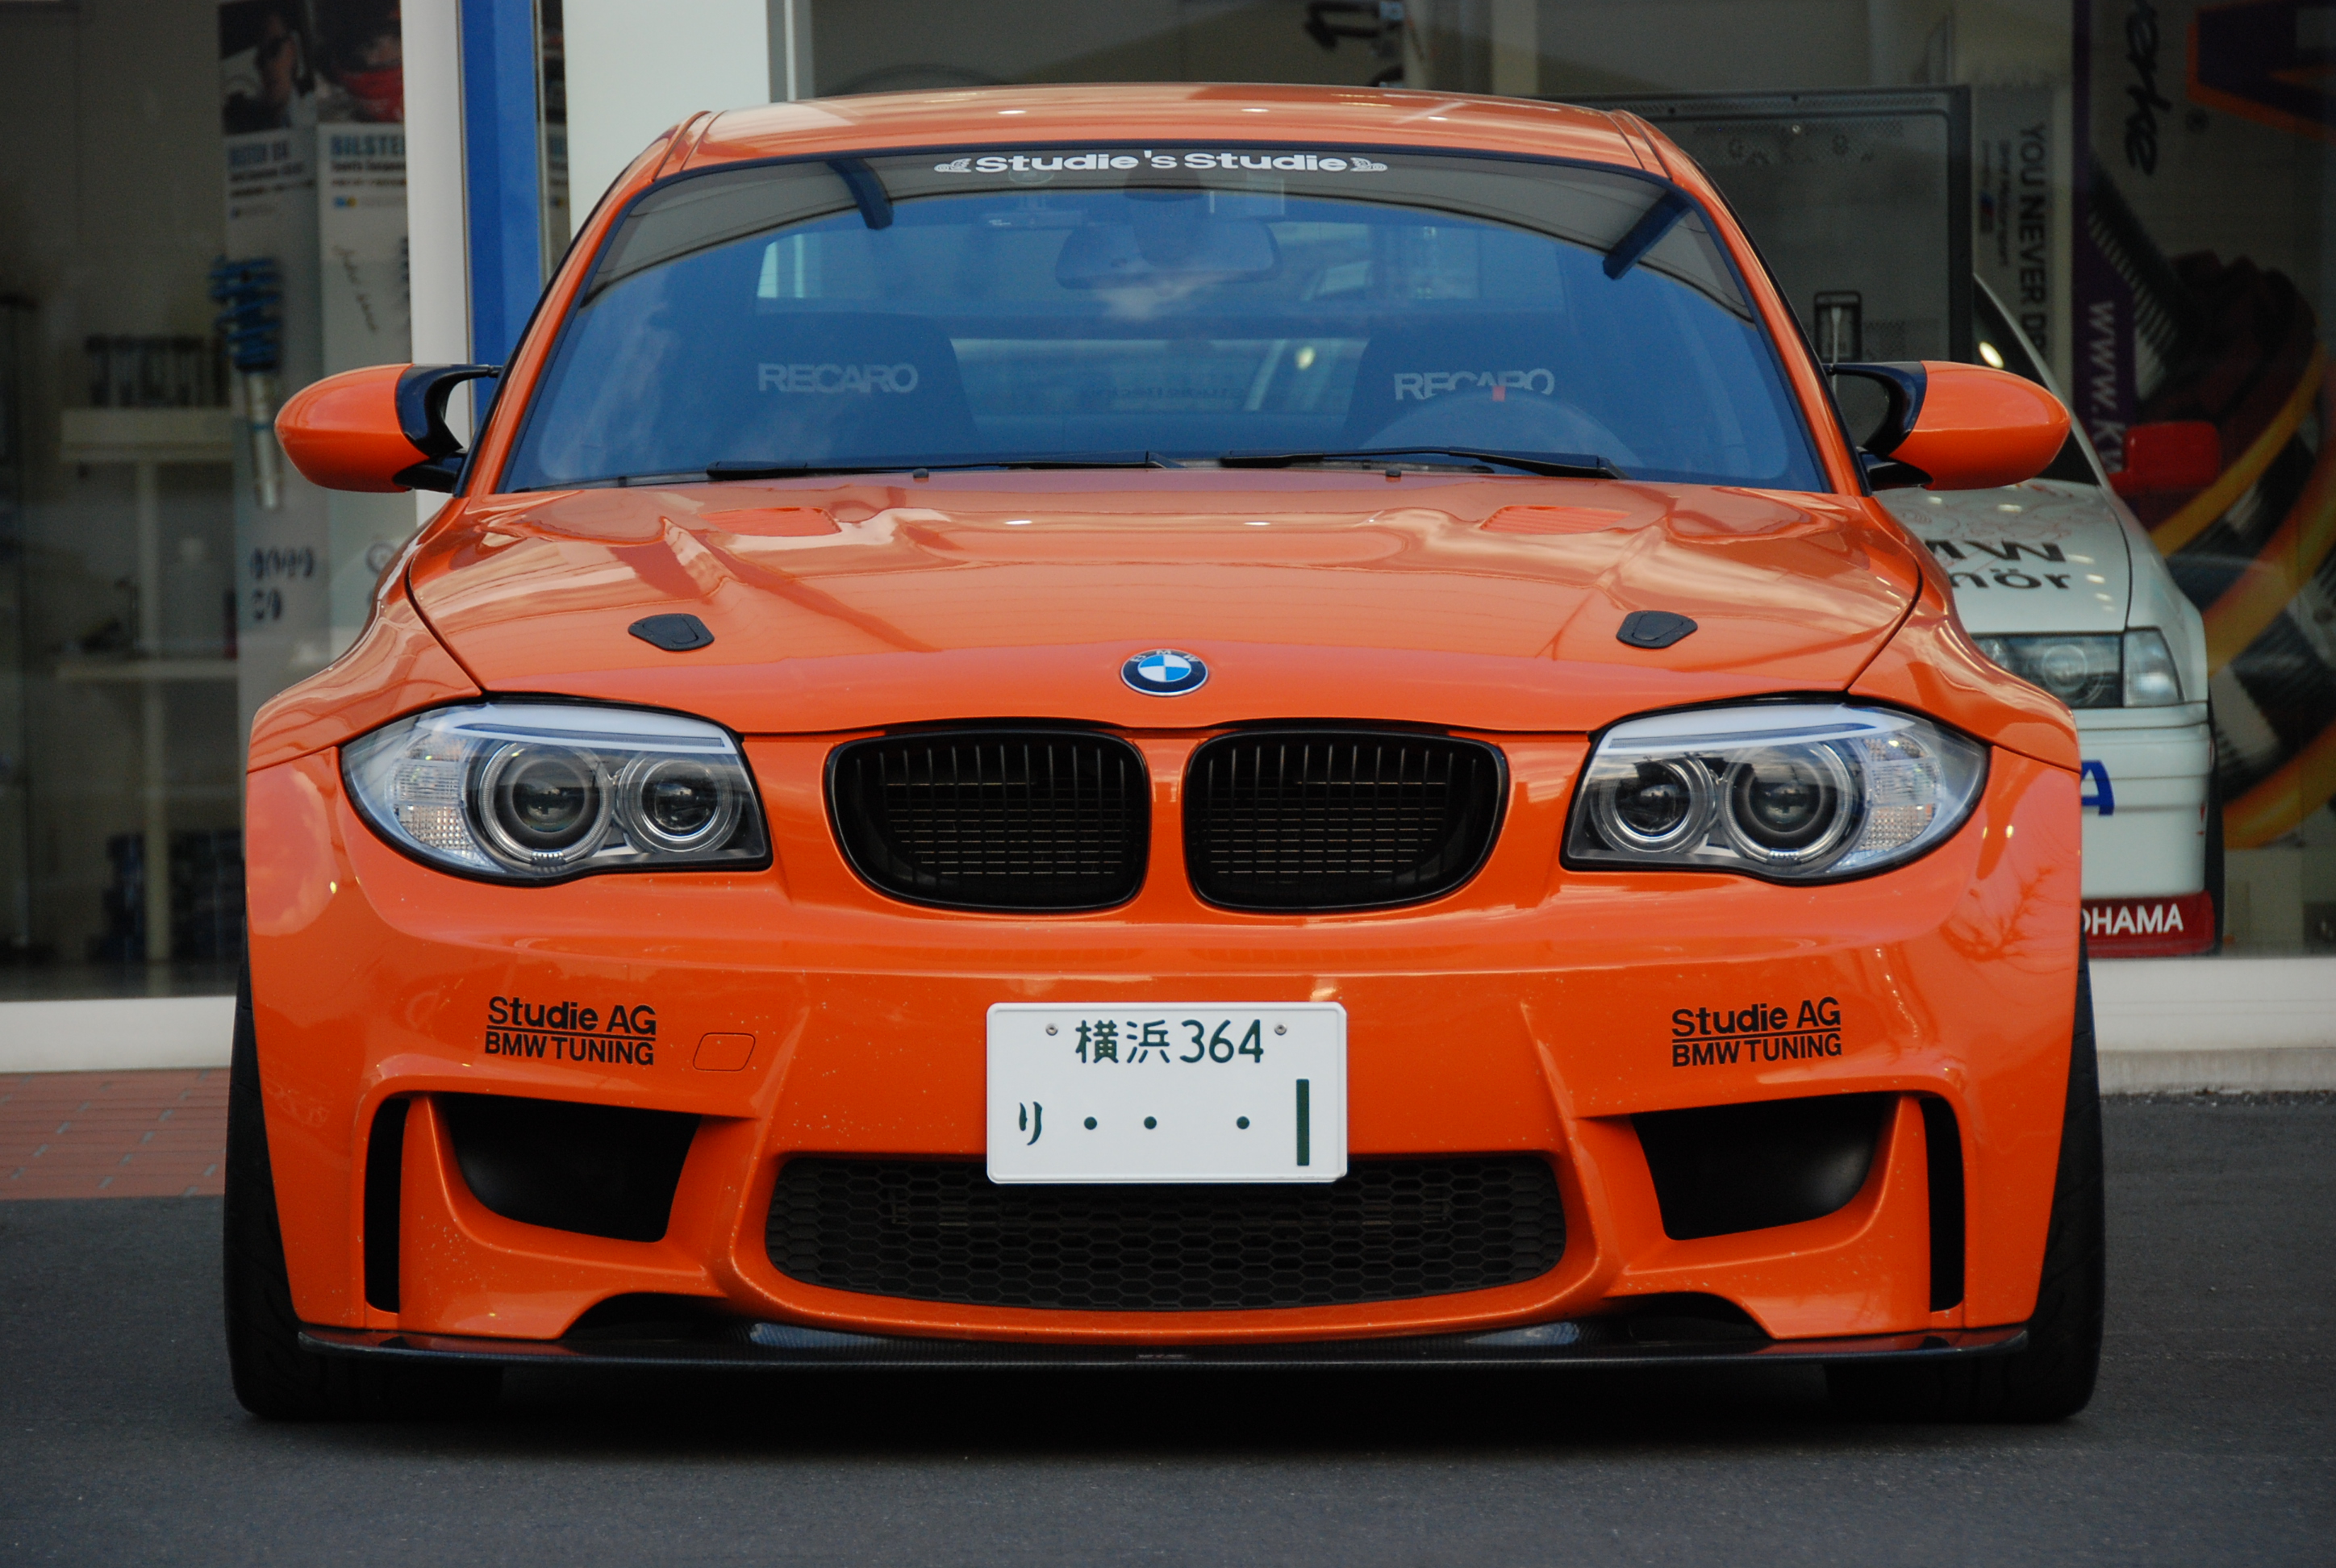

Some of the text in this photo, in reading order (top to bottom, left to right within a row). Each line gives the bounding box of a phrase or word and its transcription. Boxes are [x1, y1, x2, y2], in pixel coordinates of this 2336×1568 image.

[975, 150, 1348, 173] Studie's Studie
[2020, 124, 2046, 186] YOU
[2020, 194, 2046, 305] NEVER
[758, 363, 919, 393] RECARO
[1925, 540, 2067, 562] MW
[1131, 649, 1200, 662] BMW
[488, 996, 657, 1035] Studie AG
[1671, 996, 1842, 1036] Studie AG
[485, 1031, 654, 1065] BMW TUNING
[1672, 1032, 1842, 1067] BMW TUNING
